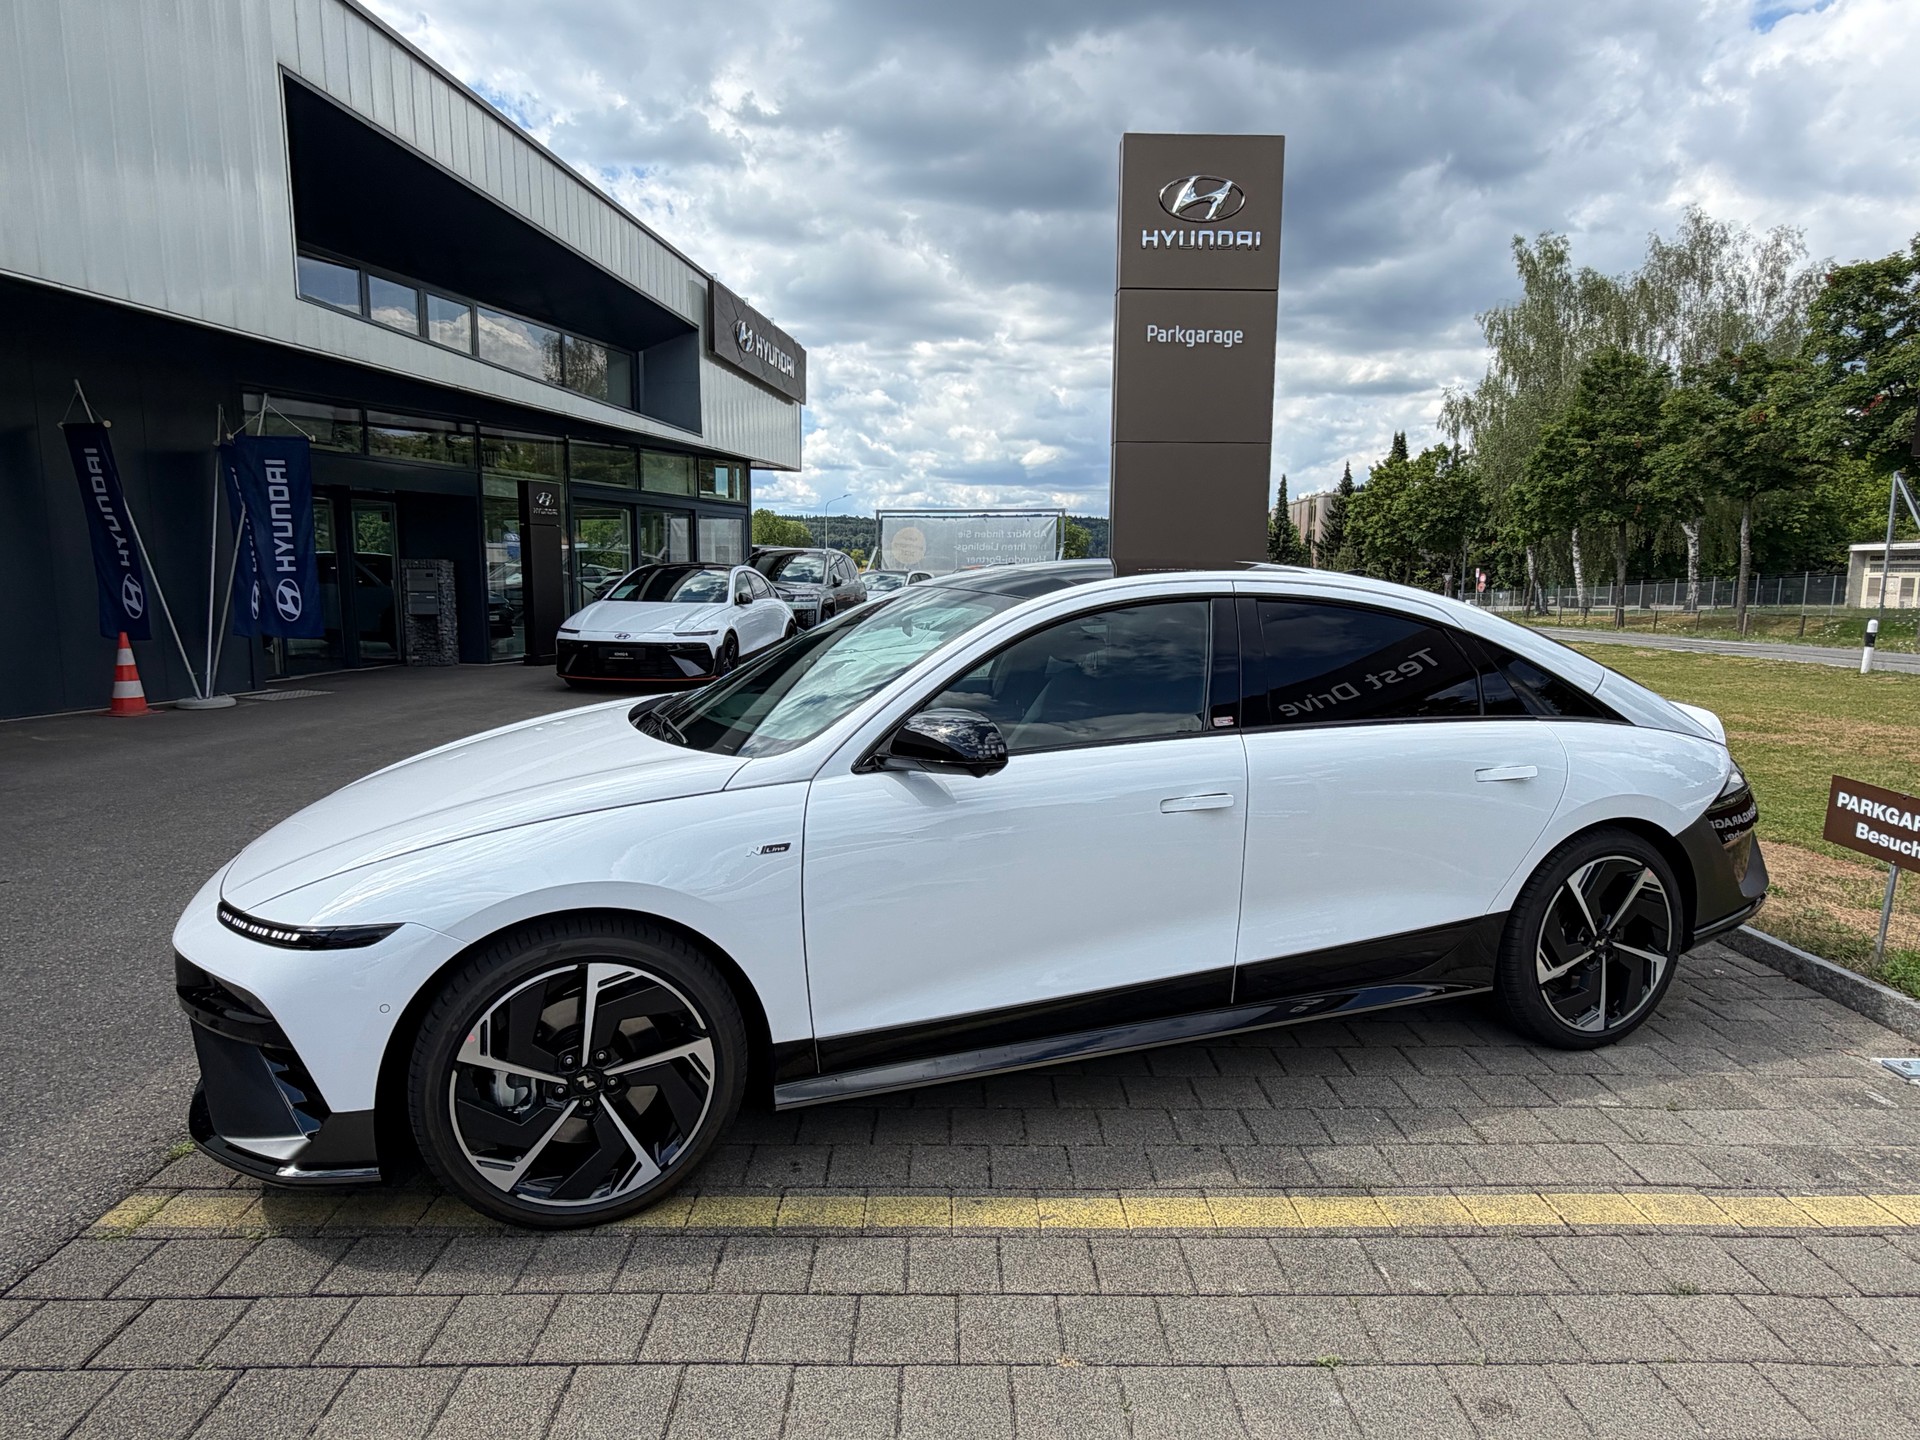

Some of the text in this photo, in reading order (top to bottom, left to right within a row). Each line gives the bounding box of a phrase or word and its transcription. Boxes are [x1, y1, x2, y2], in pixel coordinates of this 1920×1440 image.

[1141, 229, 1261, 250] HYUNDAI
[755, 333, 796, 379] HYUNDAI
[1146, 324, 1244, 348] Parkgarage
[82, 447, 130, 567] HYUNDAI
[264, 459, 297, 572] HYUNDAI
[1855, 822, 1920, 859] Besuch
